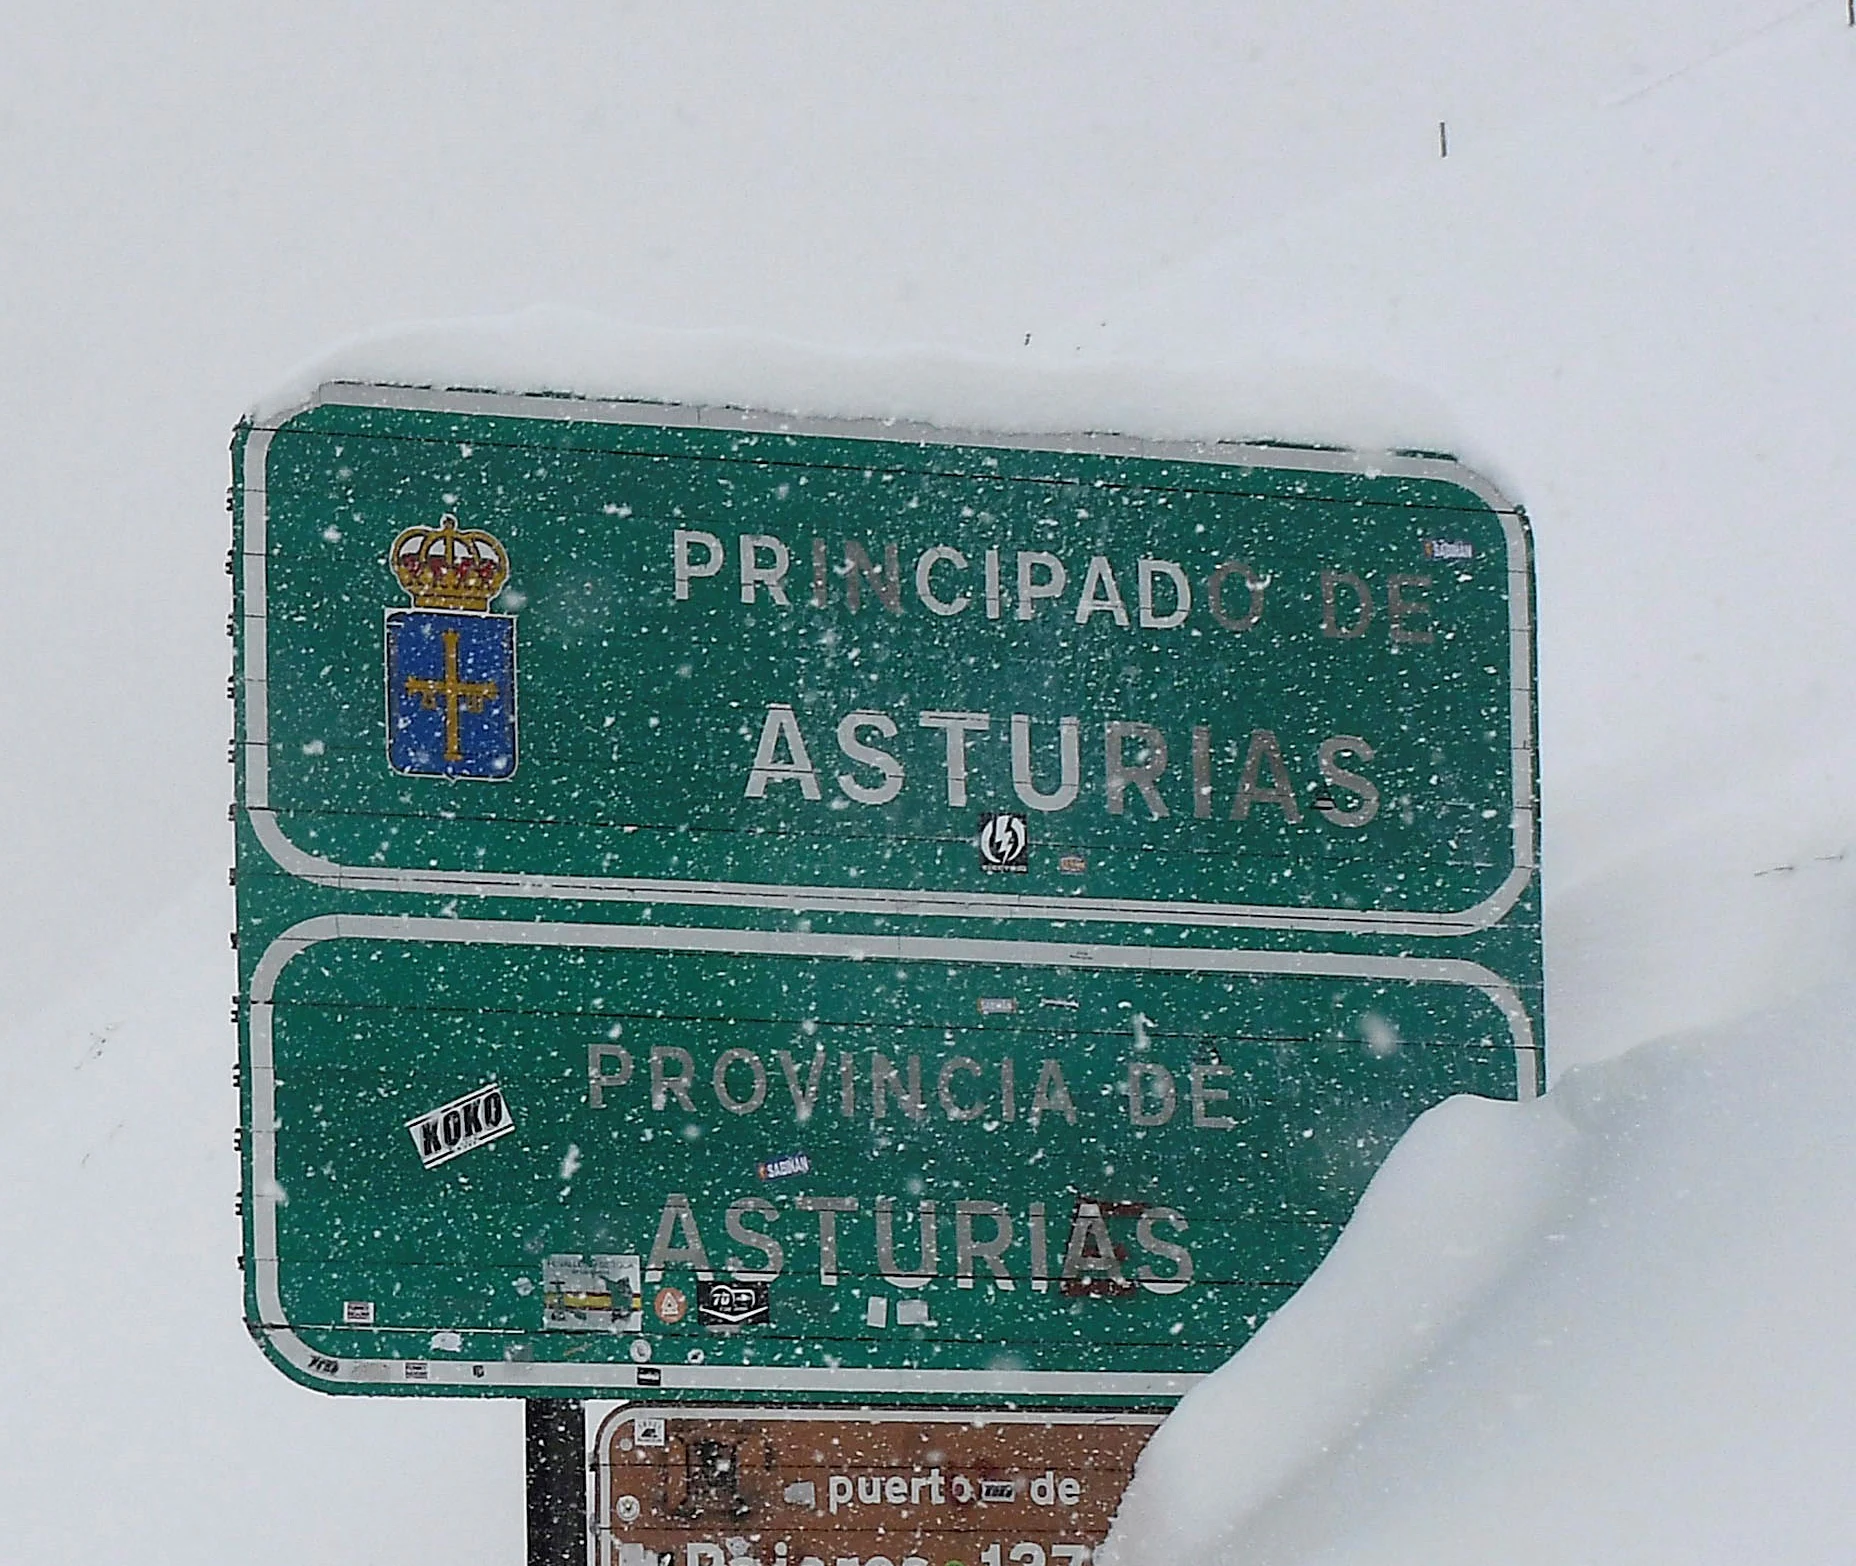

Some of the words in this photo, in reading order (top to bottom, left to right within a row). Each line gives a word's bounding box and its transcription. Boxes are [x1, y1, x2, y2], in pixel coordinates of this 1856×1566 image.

[673, 529, 1265, 632] PRINCIPADO
[1320, 567, 1435, 643] DE
[743, 702, 1379, 828] ASTURIAS
[421, 1091, 502, 1156] KOKO
[589, 1043, 1077, 1127] PROVINCIA
[1128, 1062, 1236, 1129] DE
[644, 1193, 1194, 1294] ASTURIAS
[828, 1468, 974, 1515] puerto
[1030, 1470, 1081, 1506] de
